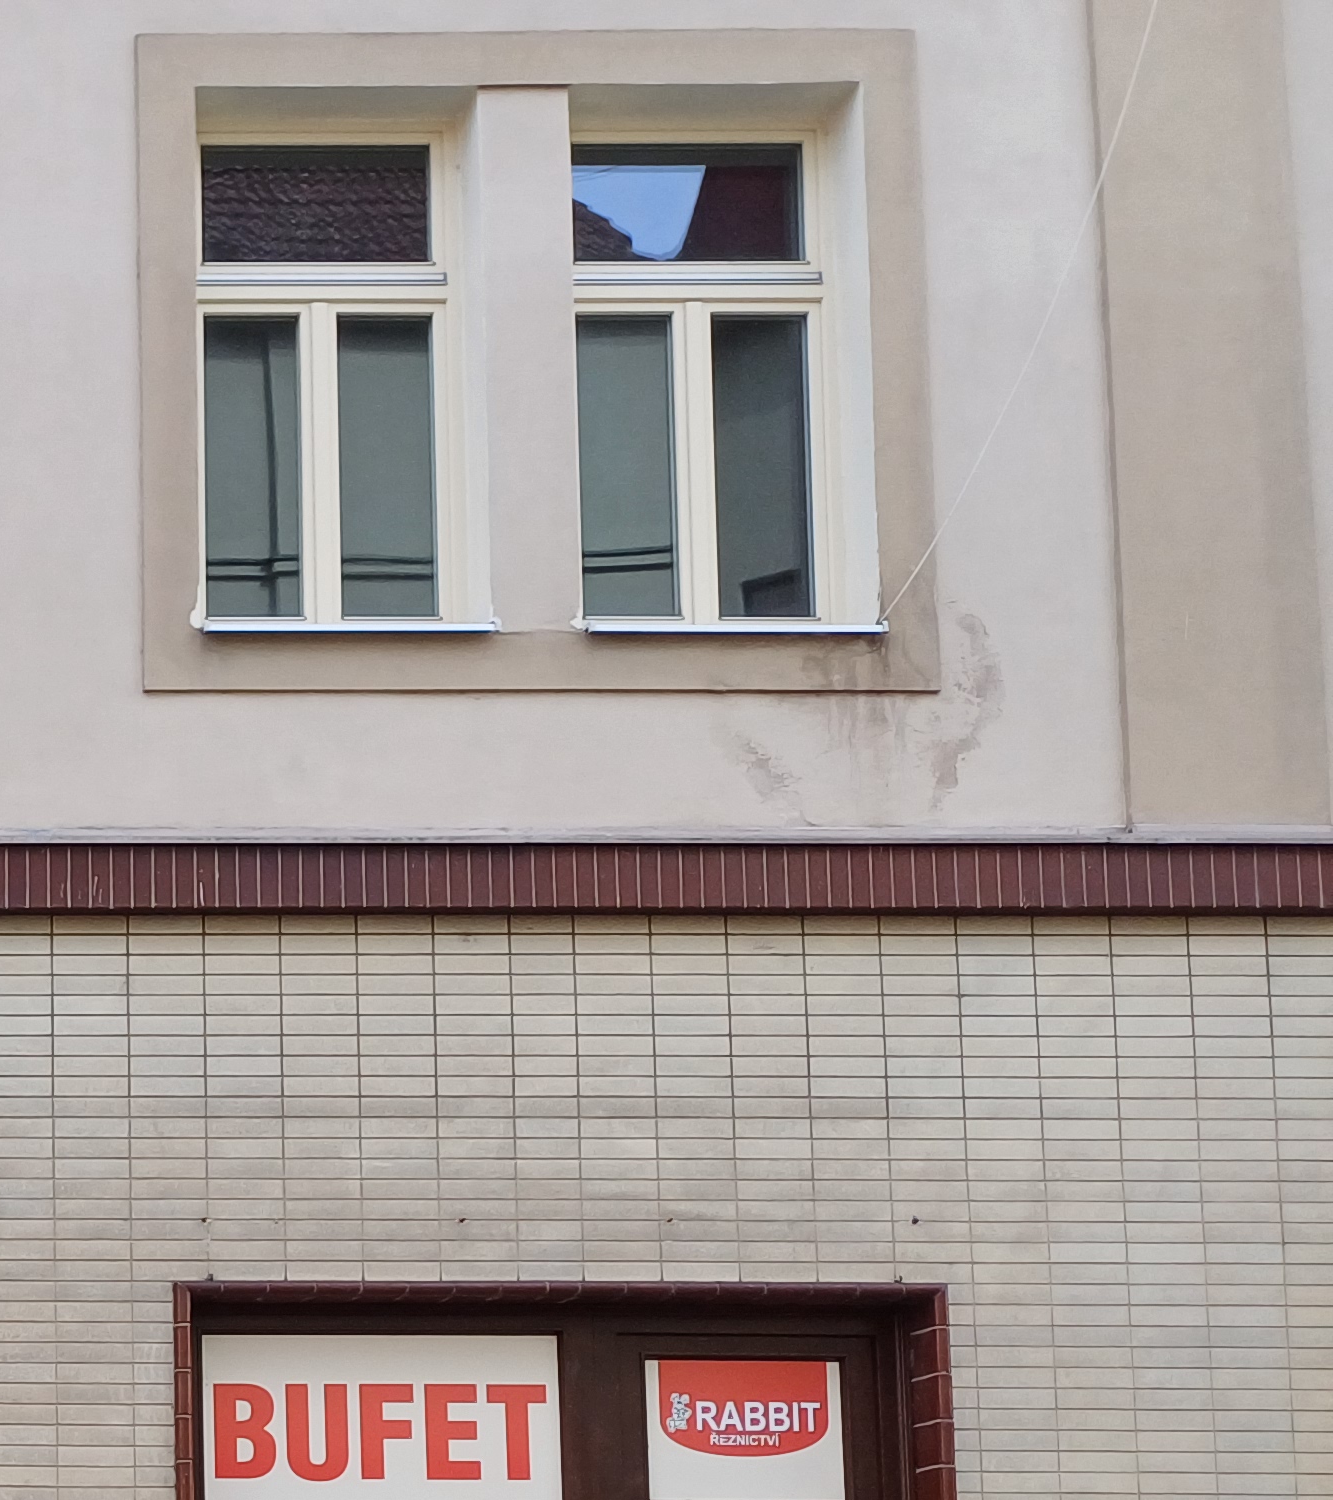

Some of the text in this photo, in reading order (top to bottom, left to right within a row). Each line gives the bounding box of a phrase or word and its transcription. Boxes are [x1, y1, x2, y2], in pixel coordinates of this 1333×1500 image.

[212, 1382, 547, 1481] BUFET
[695, 1400, 821, 1432] RABBIT
[710, 1432, 781, 1447] ŘEZNICTVÍ
